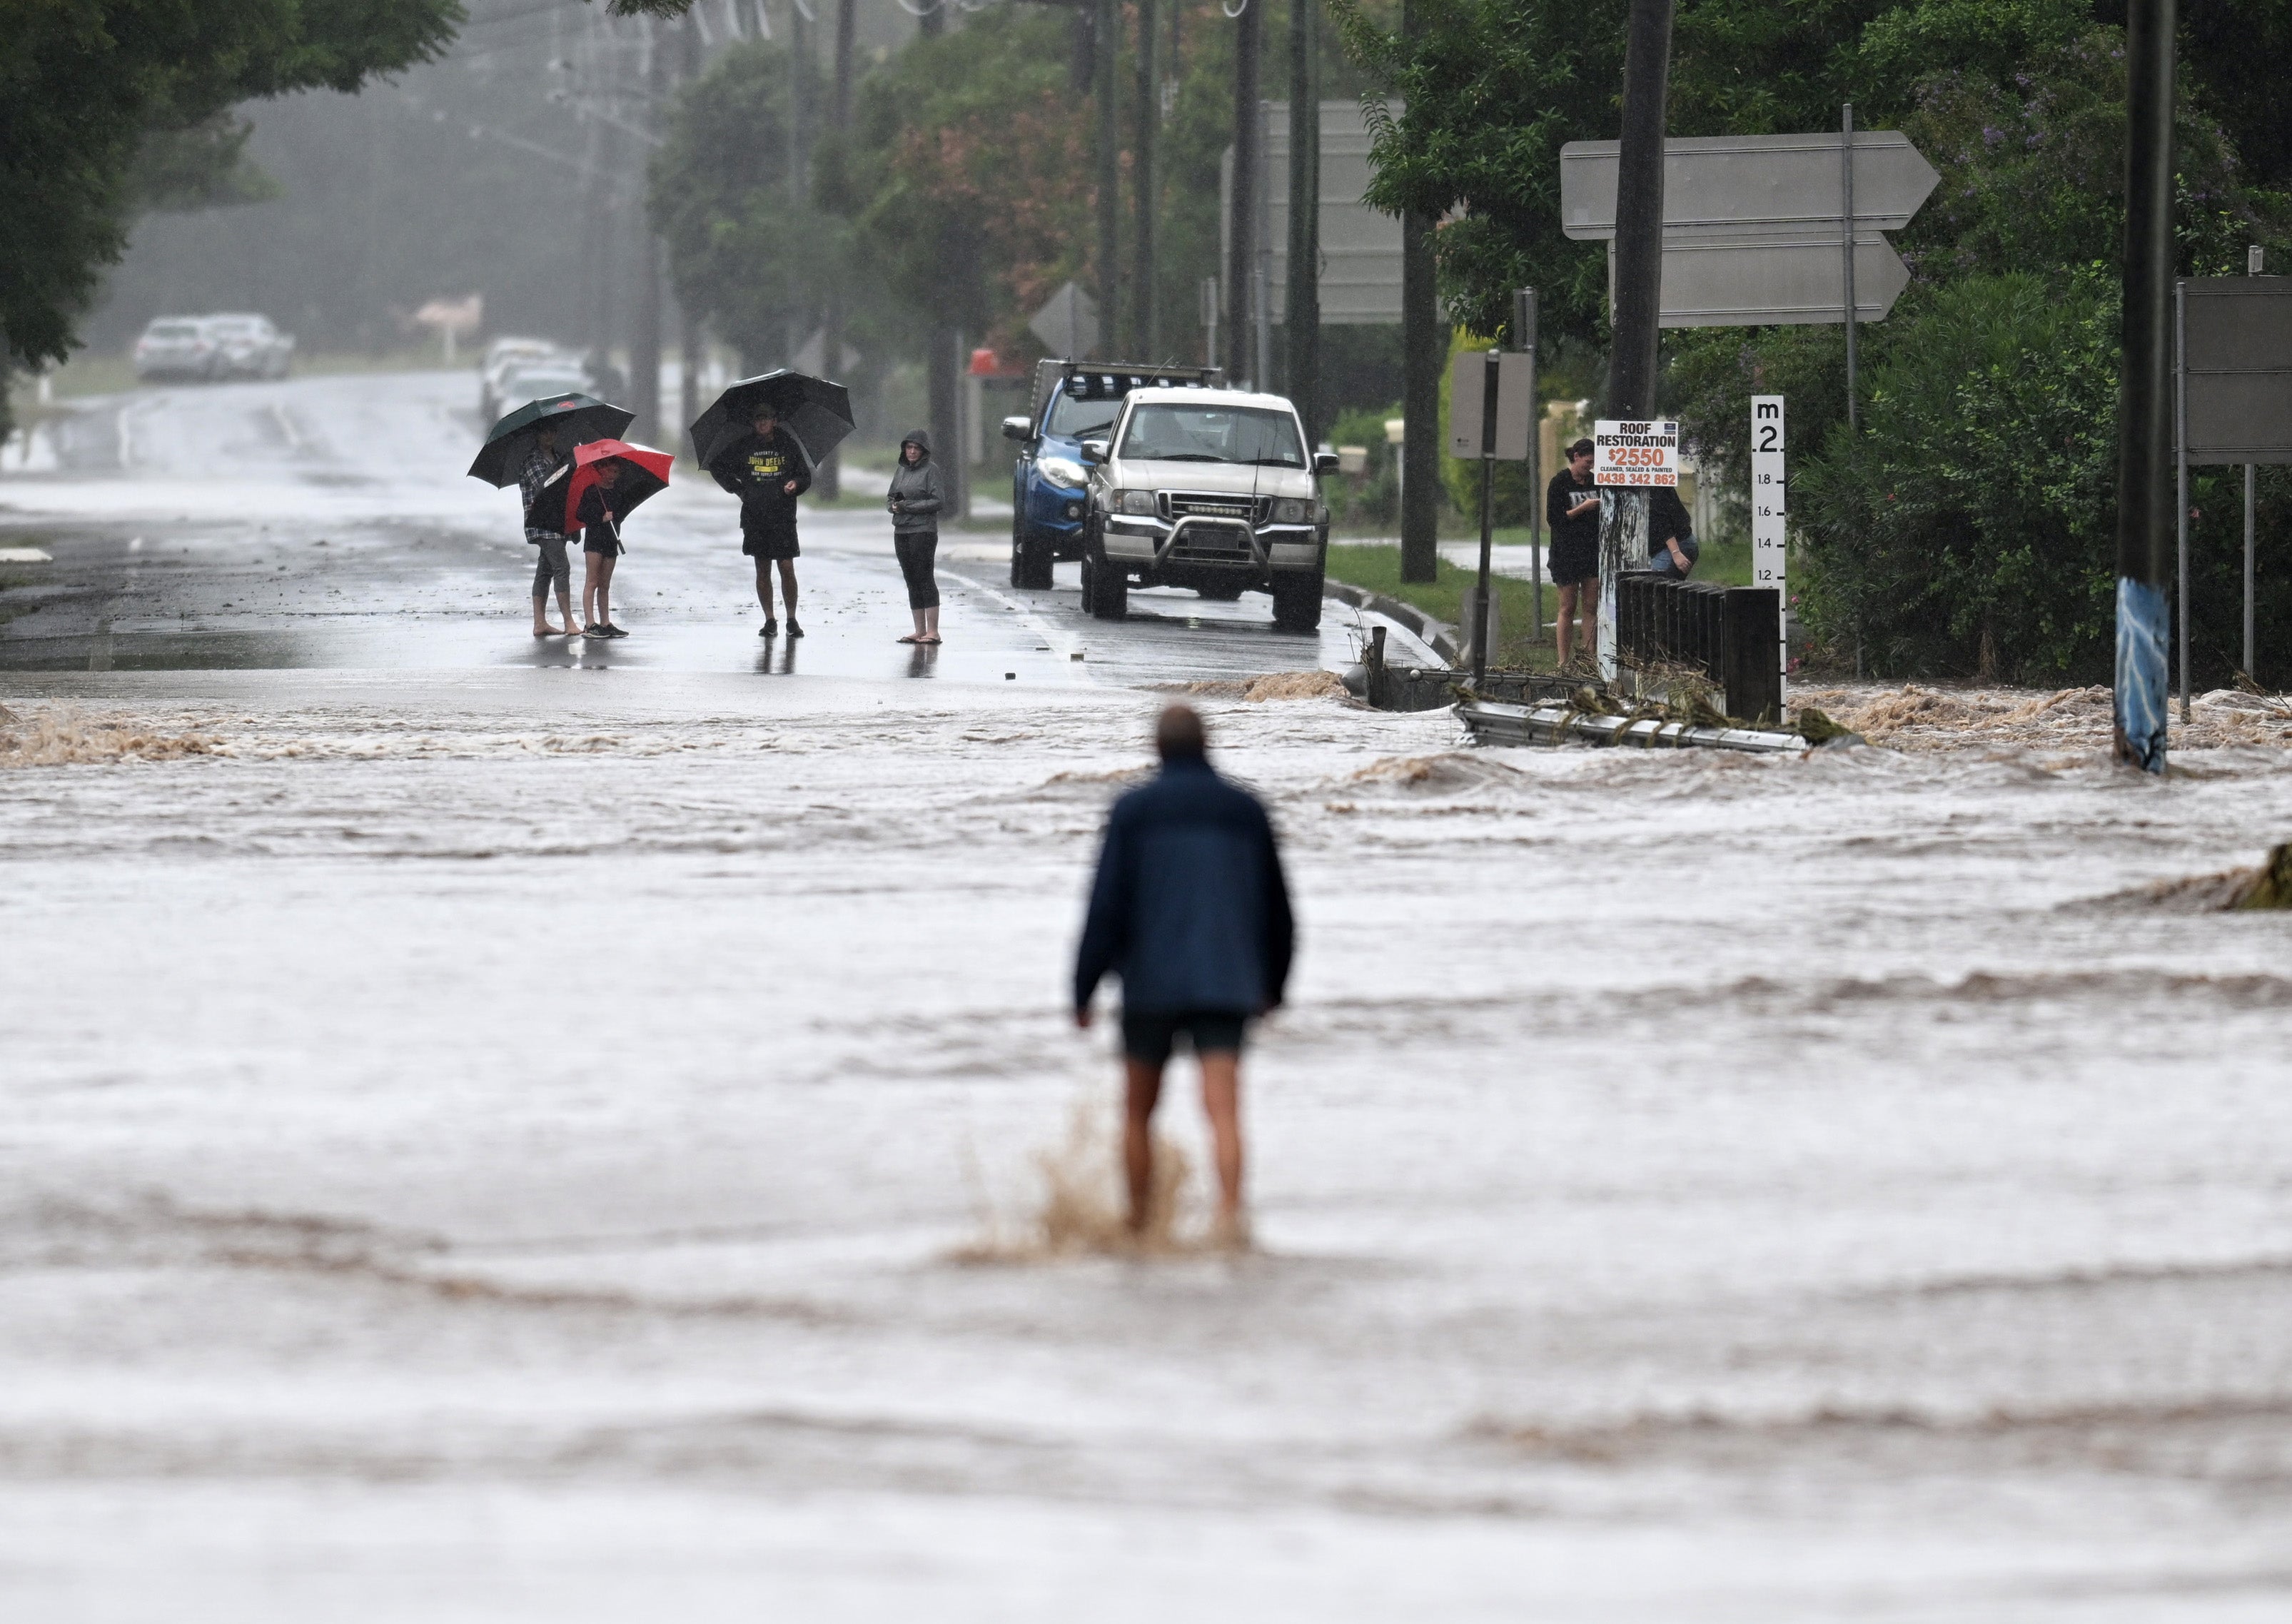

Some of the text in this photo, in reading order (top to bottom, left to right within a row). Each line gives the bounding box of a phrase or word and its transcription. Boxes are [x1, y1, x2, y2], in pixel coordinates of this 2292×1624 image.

[1757, 403, 1779, 419] m
[1620, 423, 1651, 435] ROOF
[1597, 435, 1675, 447] RESTORATION
[1760, 425, 1777, 453] 2
[748, 456, 785, 466] JOHN DEERE
[1608, 448, 1664, 466] $2550
[1597, 473, 1675, 485] 0438 342 862
[1757, 474, 1771, 485] 1.8
[1757, 506, 1771, 516] 1.6
[1758, 538, 1772, 548] 1.4
[1758, 570, 1772, 580] 1.2
